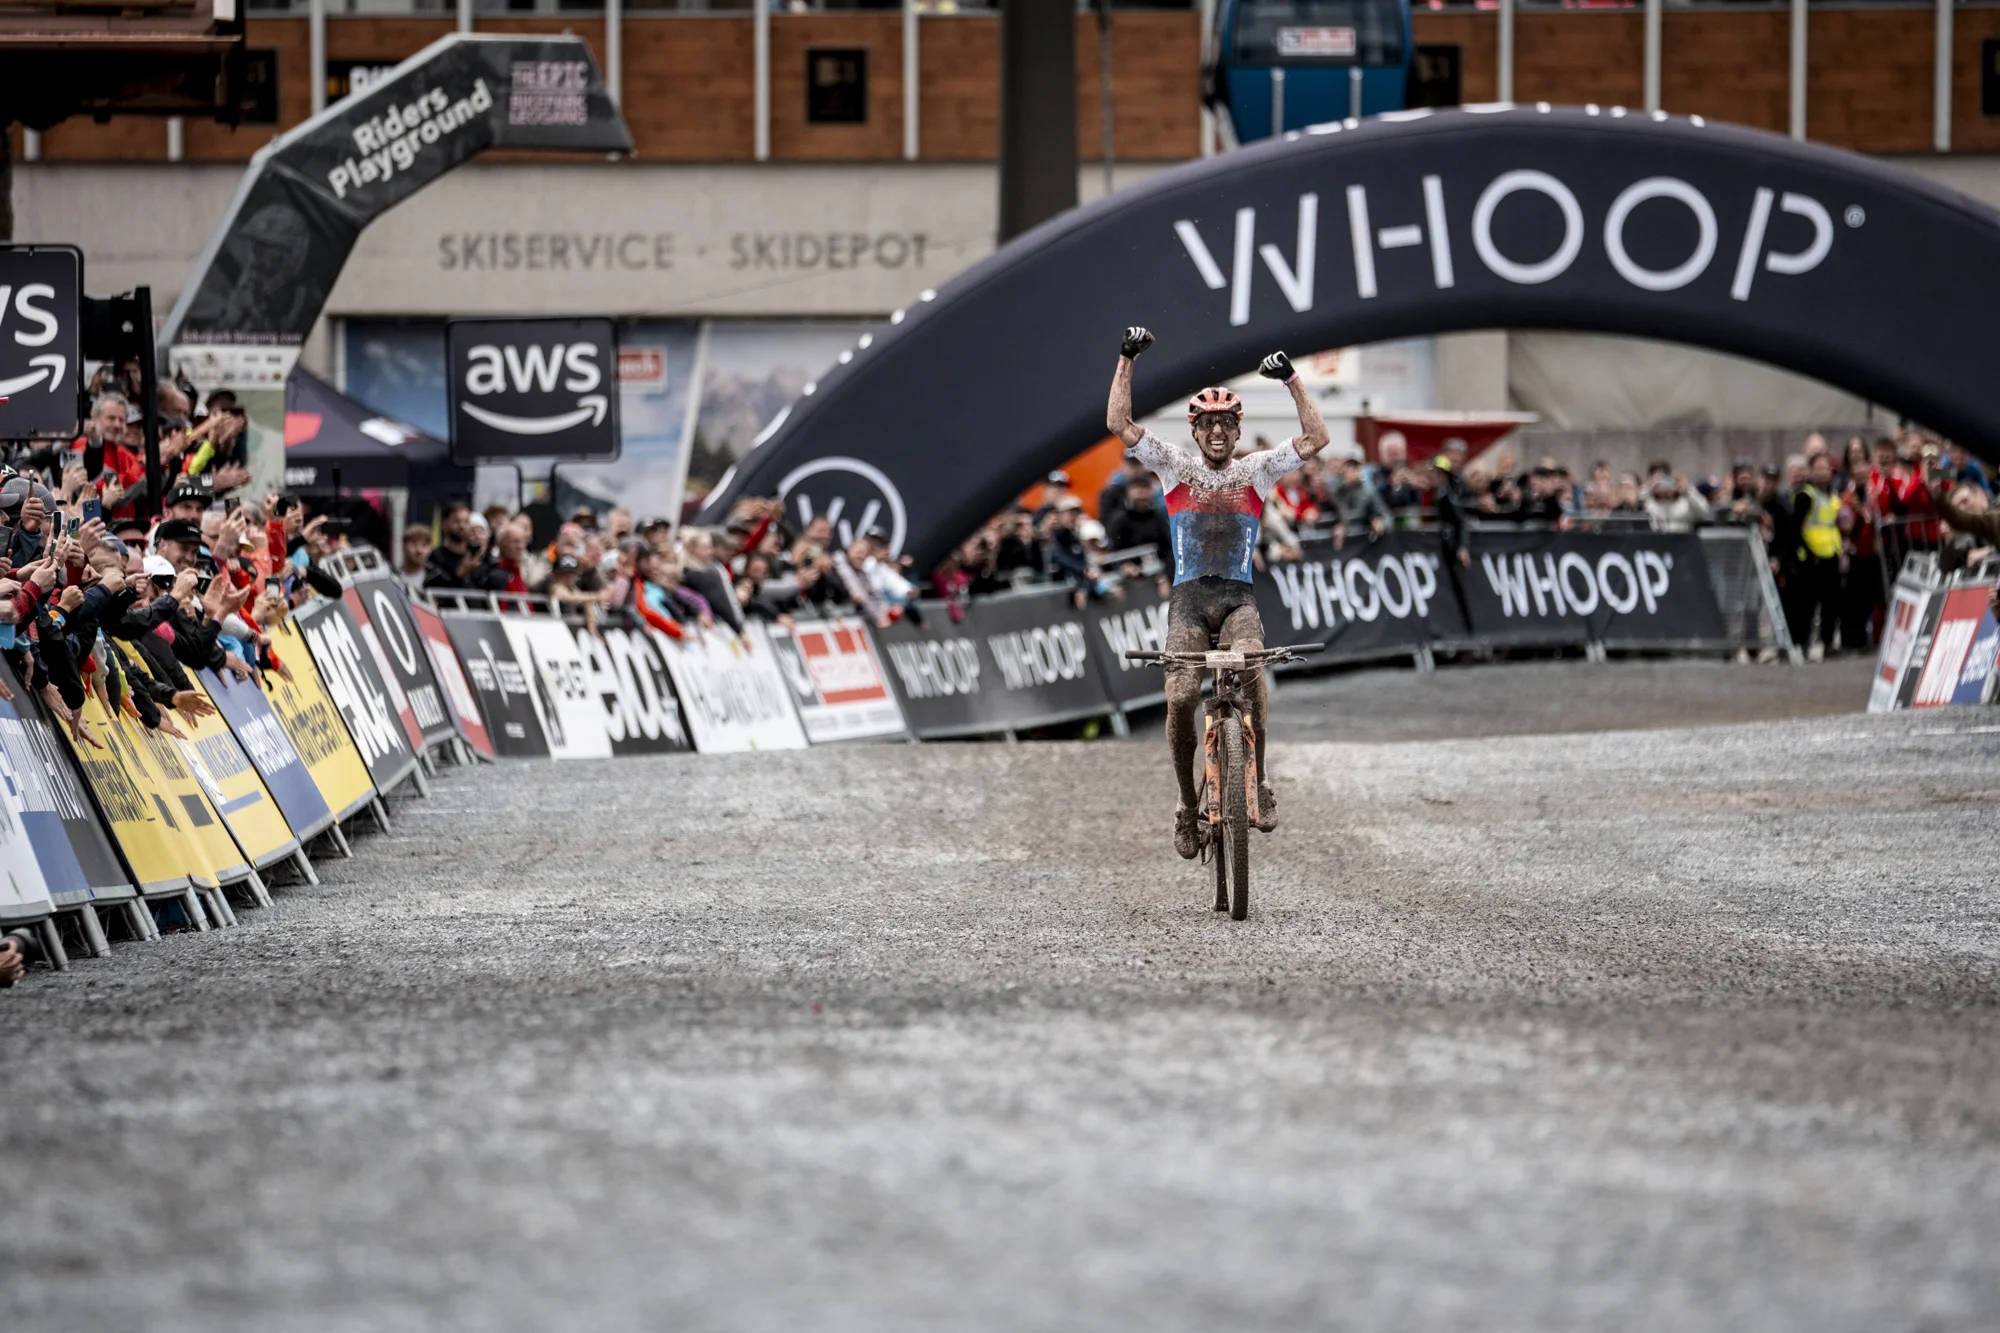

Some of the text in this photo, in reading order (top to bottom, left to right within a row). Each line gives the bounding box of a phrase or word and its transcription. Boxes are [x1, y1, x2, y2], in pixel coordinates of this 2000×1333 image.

[537, 62, 588, 89] EPIC
[328, 77, 493, 199] Playground
[352, 86, 449, 157] Riders
[438, 232, 928, 271] SKISERVICE SKIDEPOT
[465, 342, 602, 395] aws
[1240, 527, 1252, 574] CUBE
[886, 637, 981, 699] WHOOP
[987, 621, 1087, 691] WHOOP
